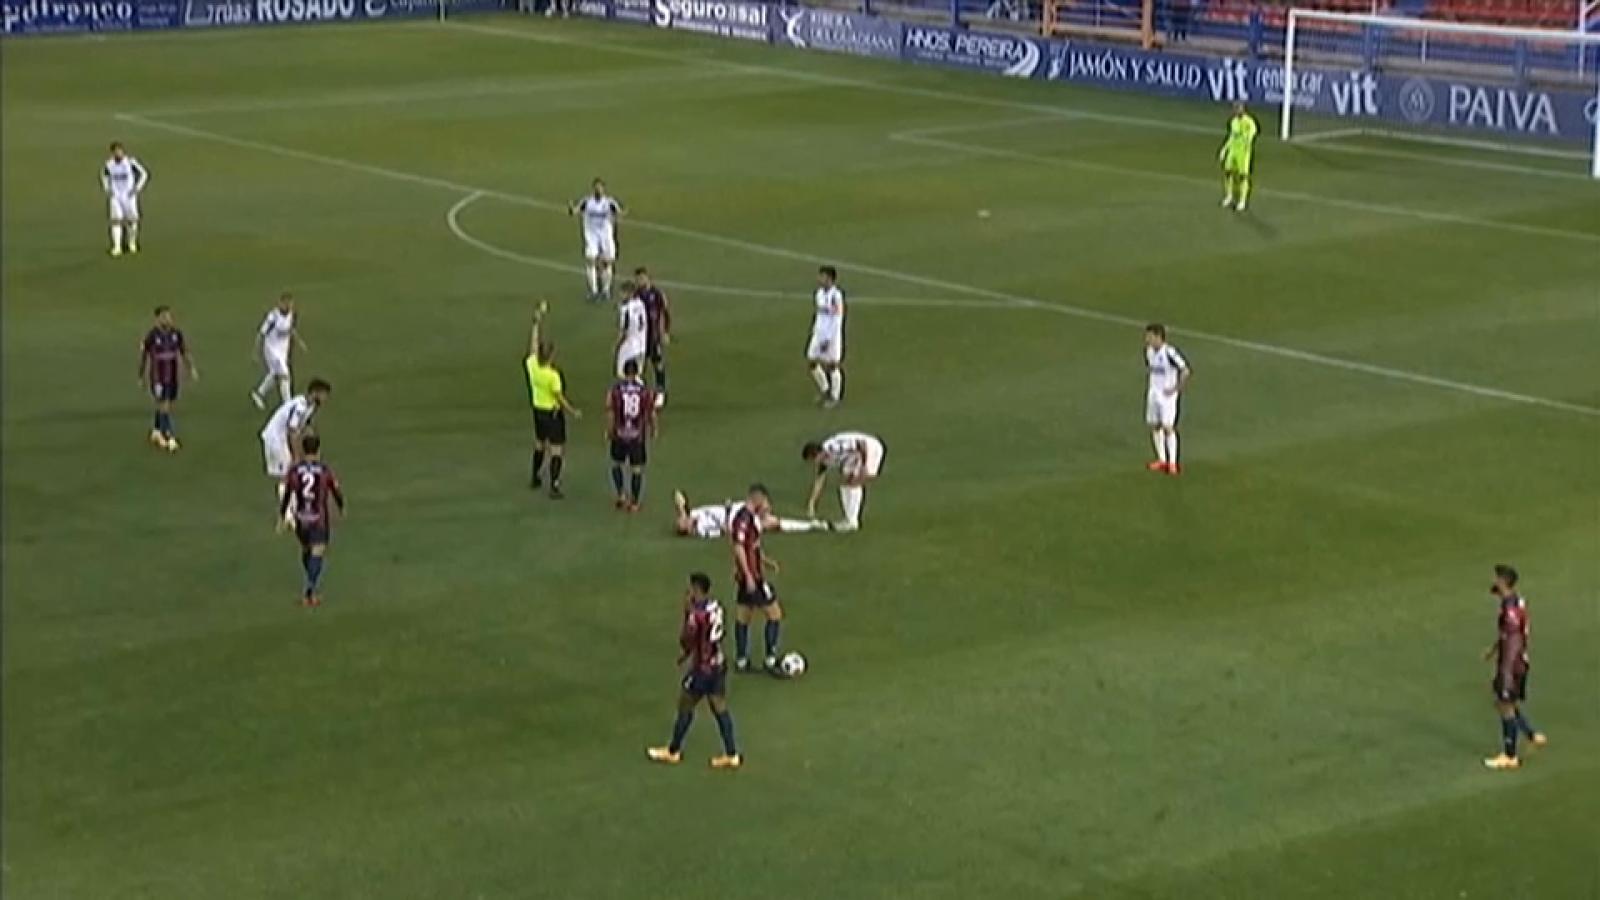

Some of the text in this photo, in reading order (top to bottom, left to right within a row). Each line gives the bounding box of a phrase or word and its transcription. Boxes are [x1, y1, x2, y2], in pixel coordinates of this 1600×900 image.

[1068, 49, 1201, 90] JAMÓN Y SALUD
[1208, 56, 1249, 102] vit
[1331, 69, 1378, 116] vit
[1449, 83, 1560, 135] PAIVA
[622, 392, 641, 418] 18
[301, 471, 317, 500] 2
